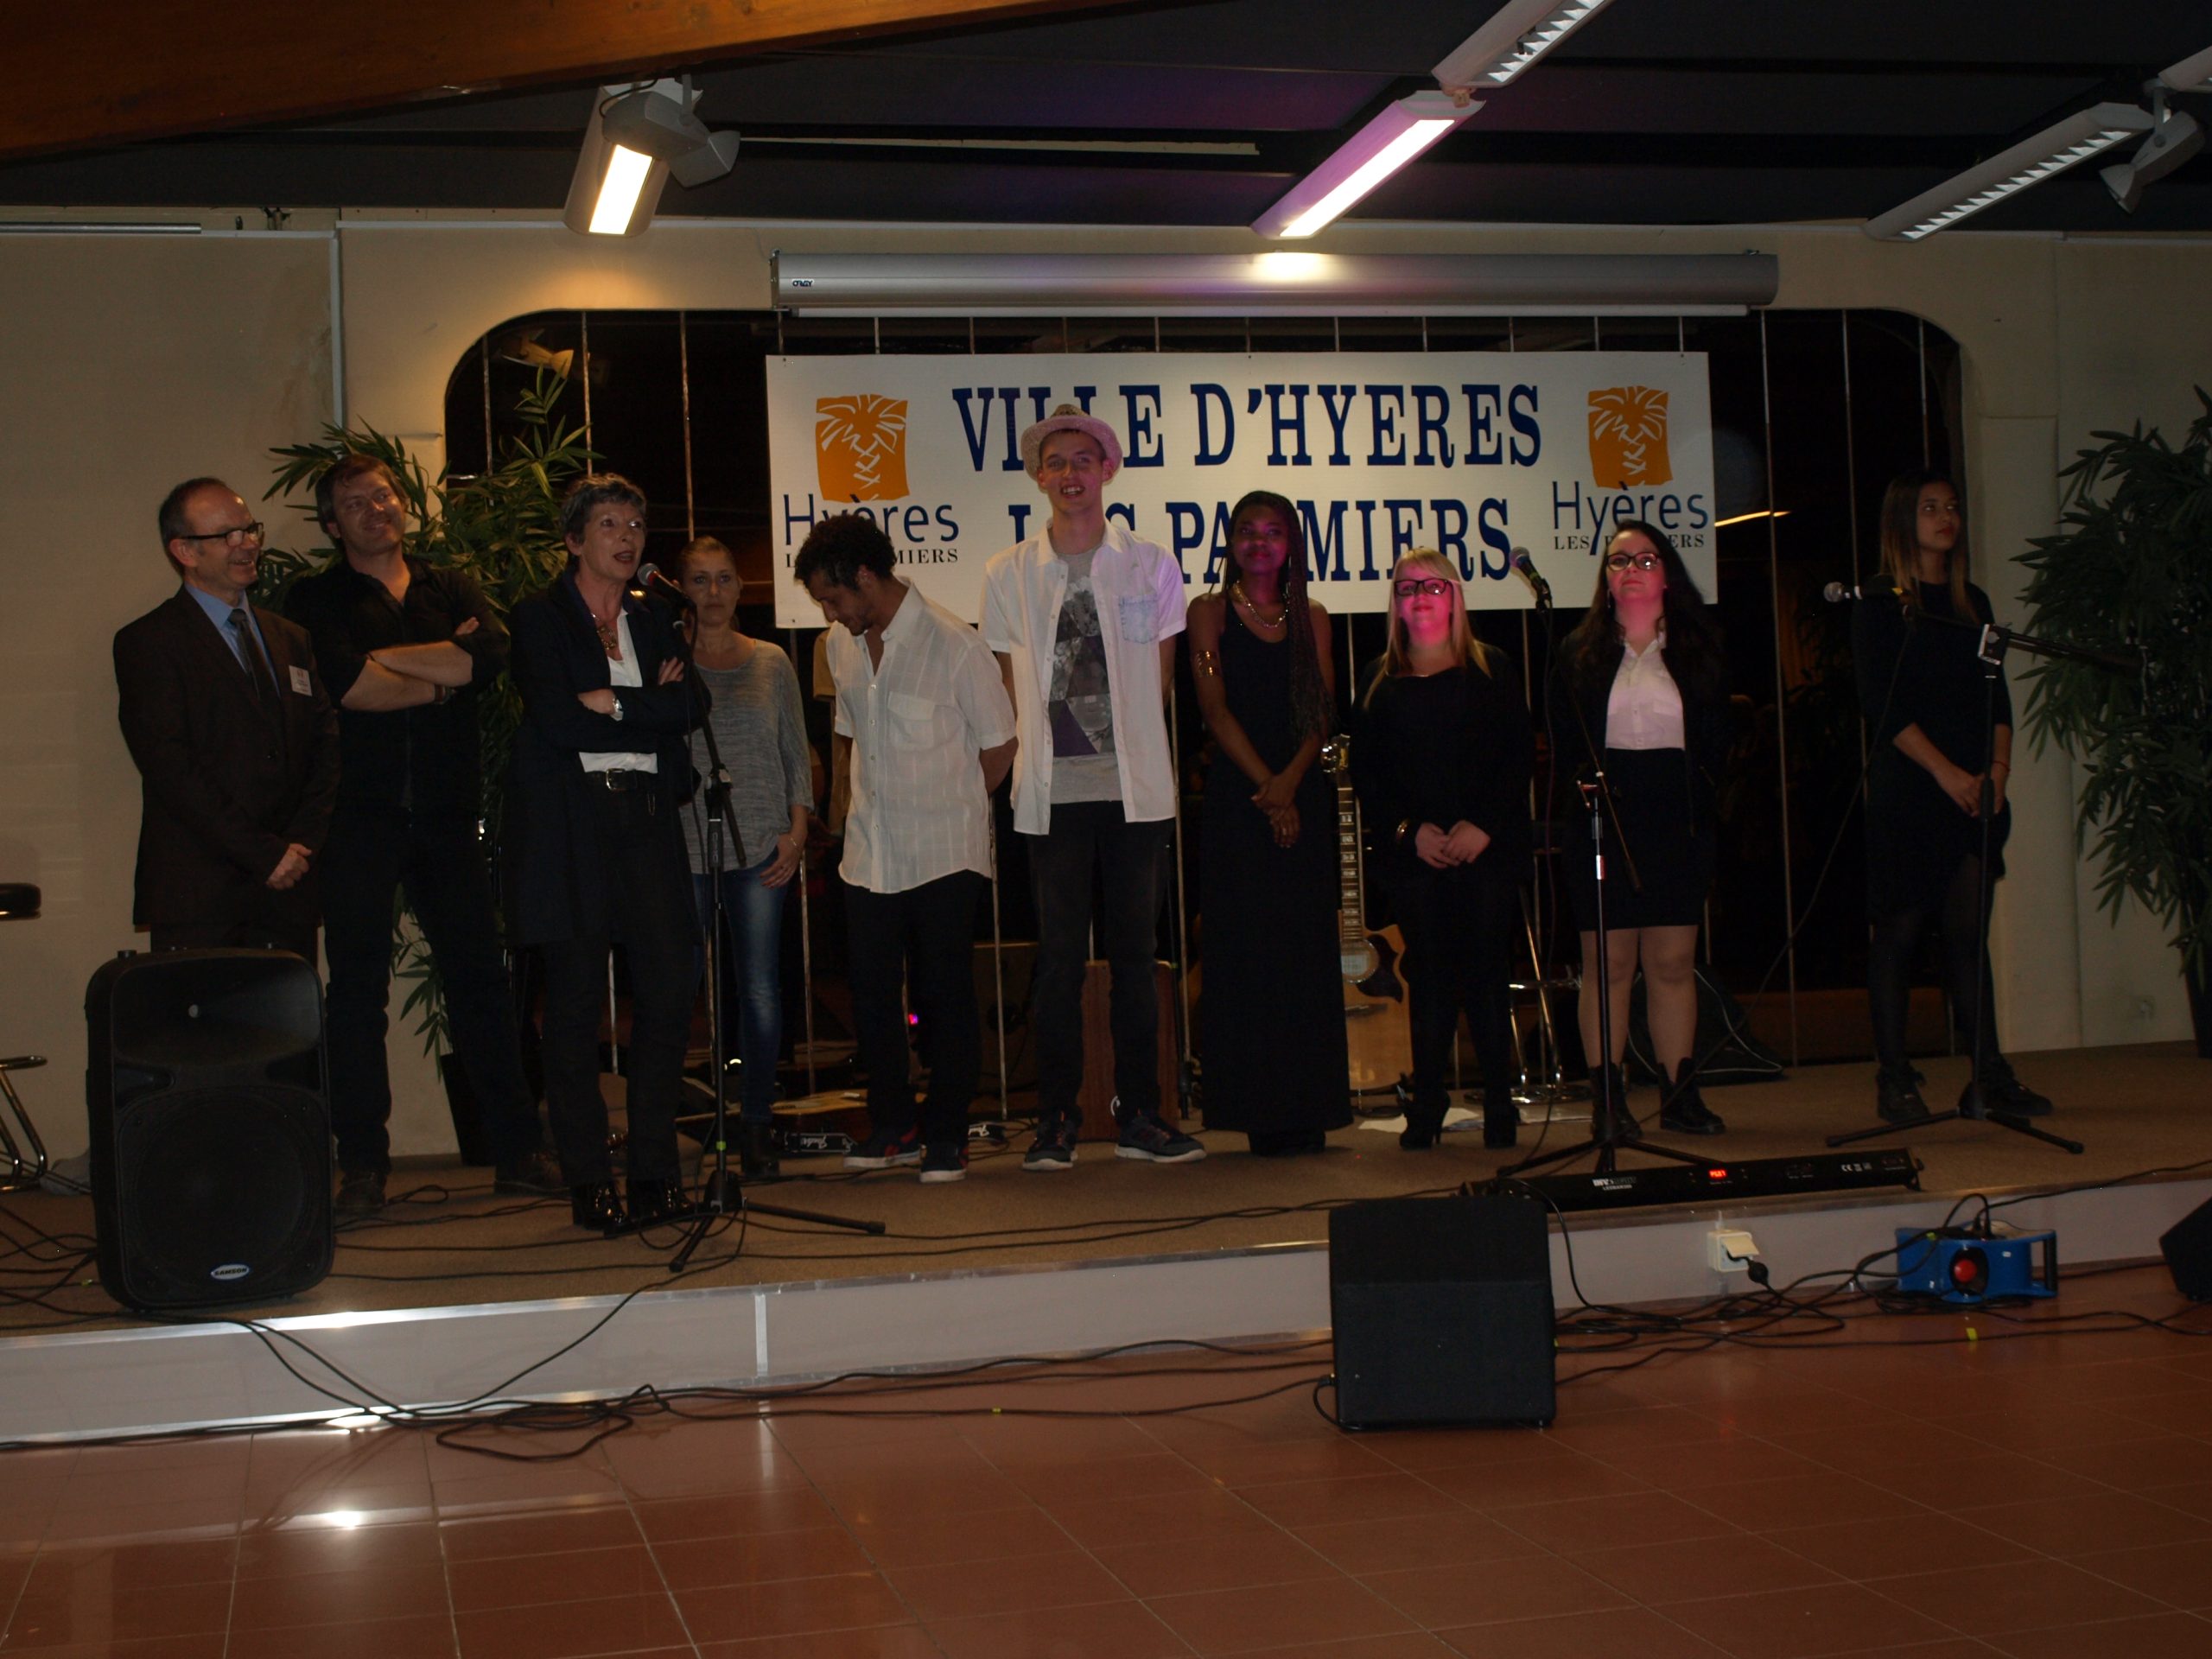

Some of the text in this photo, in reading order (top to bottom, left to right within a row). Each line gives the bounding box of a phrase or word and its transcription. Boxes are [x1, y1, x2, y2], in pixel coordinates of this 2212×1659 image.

[1191, 383, 1541, 467] D'HYERES
[1165, 498, 1510, 583] PAMIERS
[1554, 536, 1590, 550] LES
